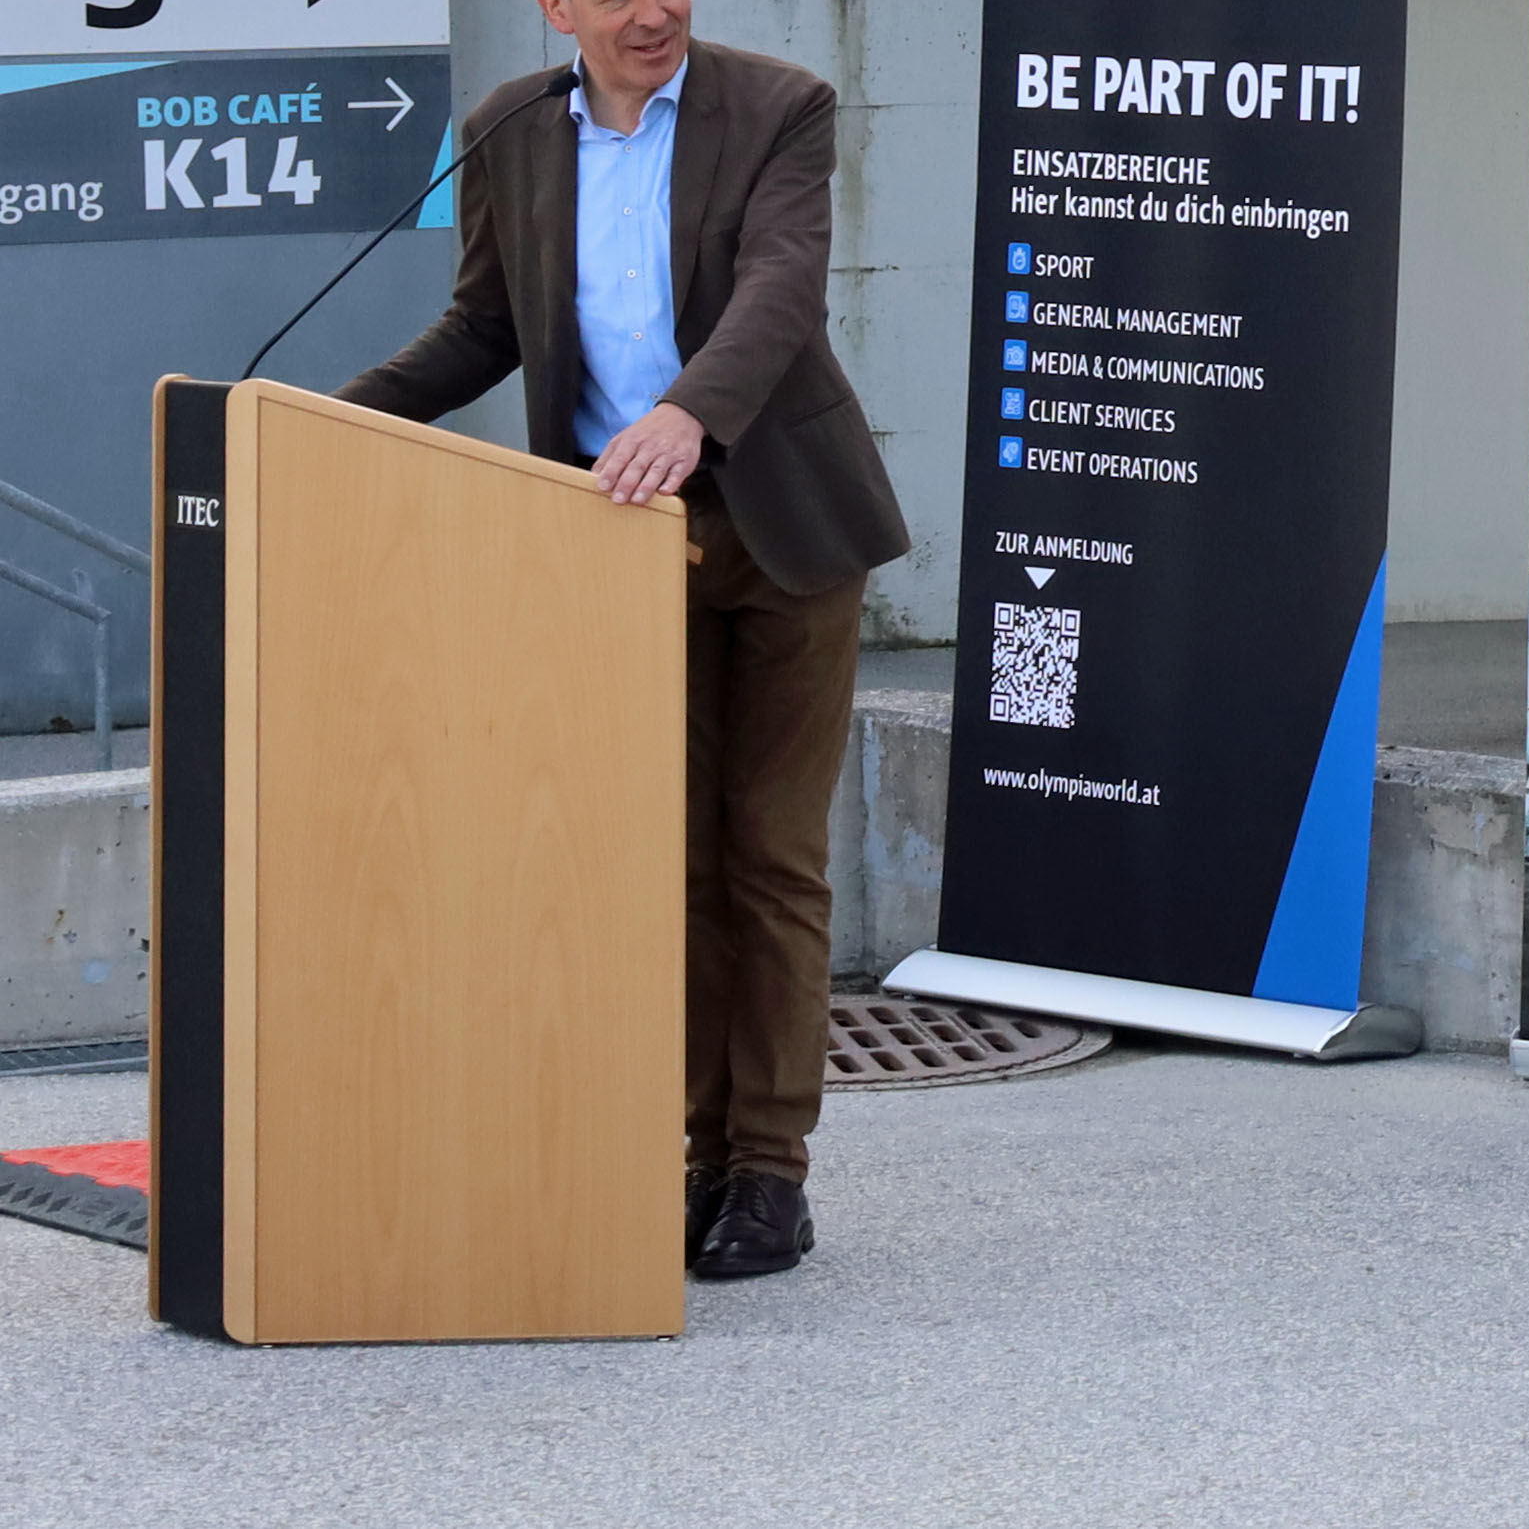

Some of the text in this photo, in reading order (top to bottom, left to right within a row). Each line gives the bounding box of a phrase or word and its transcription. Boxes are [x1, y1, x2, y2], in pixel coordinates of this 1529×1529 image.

[138, 82, 323, 128] BOB CAFÉ
[1016, 53, 1361, 124] BE PART OF IT!
[144, 136, 322, 211] K14
[1013, 148, 1210, 185] EINSATZBEREICHE
[1011, 187, 1350, 239] Hier kannst du dich einbringen
[1035, 254, 1094, 279] SPORT
[1033, 302, 1242, 338] GENERAL MANAGEMENT
[1031, 350, 1265, 390] MEDIA & COMMUNICATIONS
[1028, 399, 1175, 433] CLIENT SERVICES
[1027, 447, 1198, 484] EVENT OPERATIONS
[177, 495, 220, 527] ITEC
[995, 531, 1134, 565] ZUR ANMELDUNG
[984, 767, 1161, 806] www.olympiaworld.at
